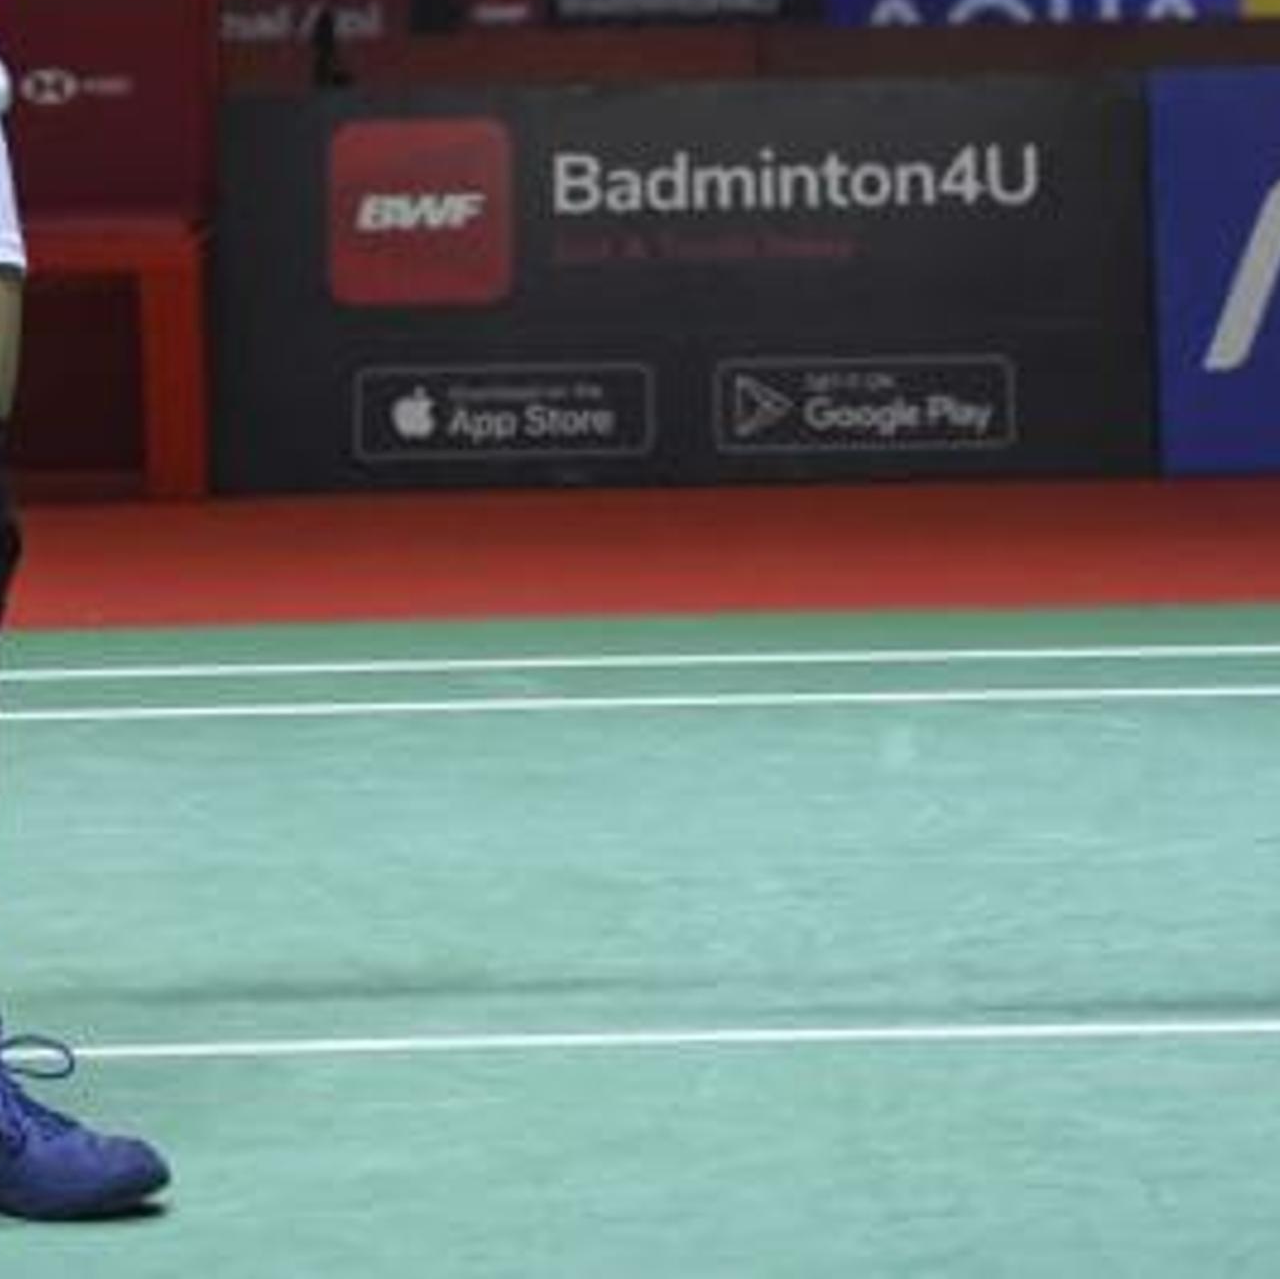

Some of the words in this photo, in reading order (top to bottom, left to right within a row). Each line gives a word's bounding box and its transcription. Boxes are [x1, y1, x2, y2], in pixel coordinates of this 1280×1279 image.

[552, 145, 1040, 214] Badminton4U
[355, 193, 485, 231] BWF
[447, 408, 517, 443] App
[524, 405, 615, 436] Store
[803, 397, 918, 434] Google
[927, 395, 993, 433] Play
